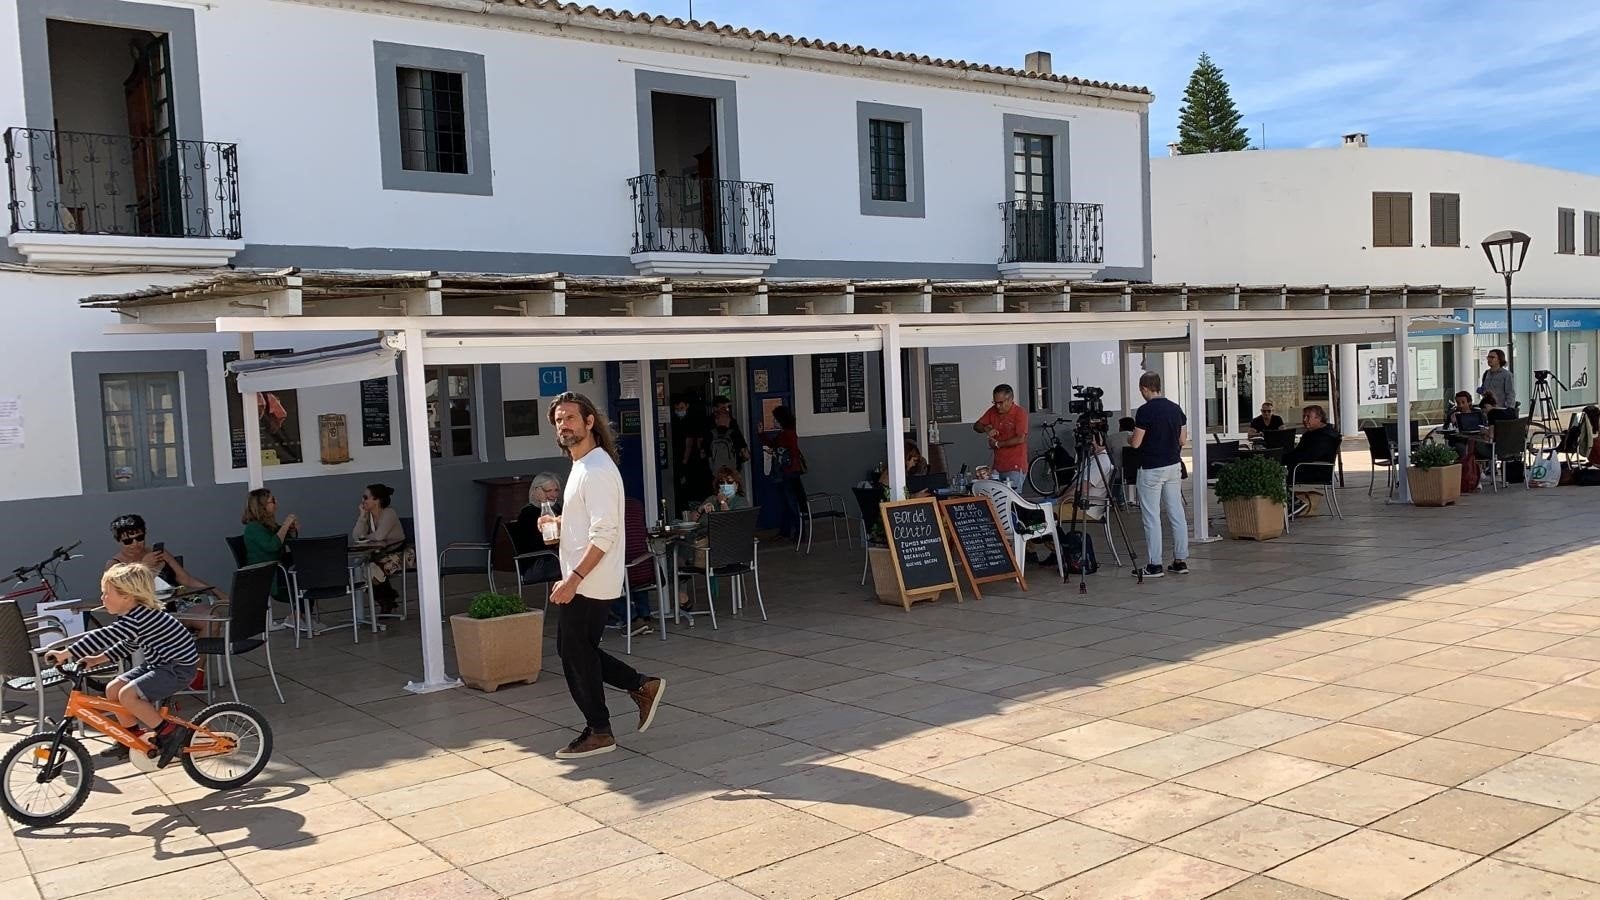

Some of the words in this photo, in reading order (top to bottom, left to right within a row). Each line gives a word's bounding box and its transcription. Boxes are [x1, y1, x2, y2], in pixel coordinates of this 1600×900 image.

[542, 371, 563, 385] CH
[893, 511, 911, 525] Bar
[912, 508, 927, 523] del
[893, 524, 932, 540] Centro
[901, 540, 920, 549] ZUMOS
